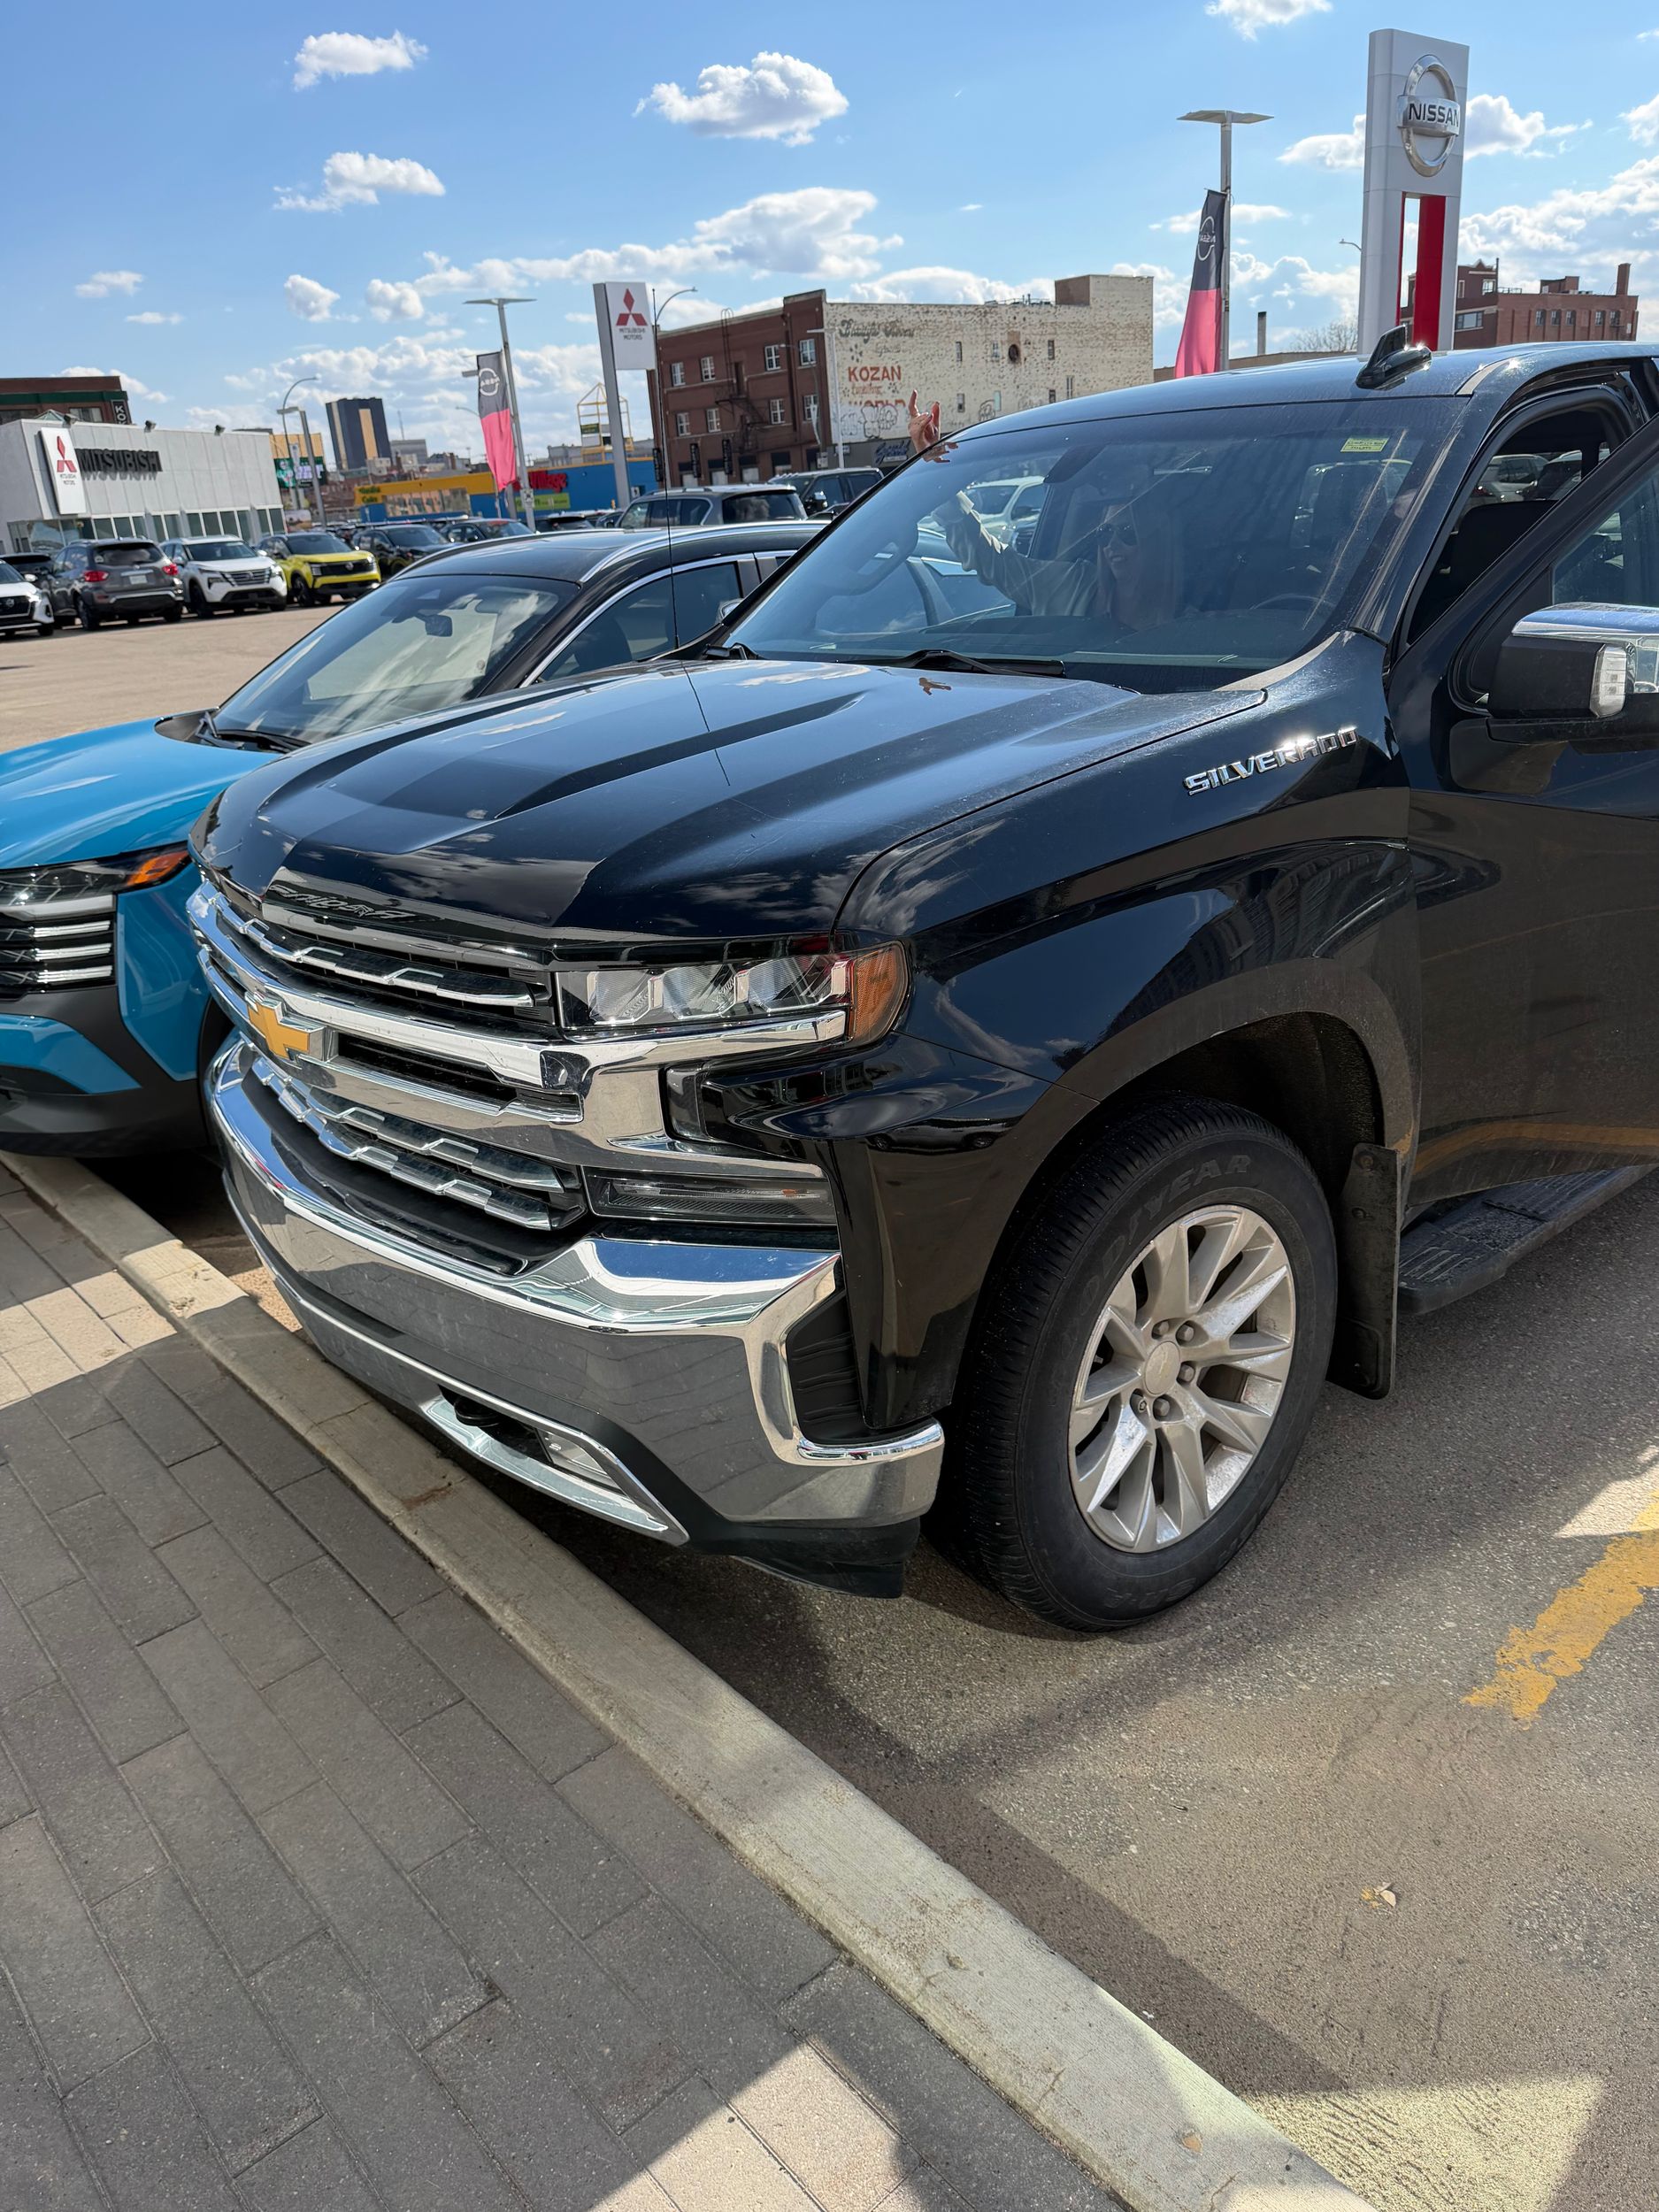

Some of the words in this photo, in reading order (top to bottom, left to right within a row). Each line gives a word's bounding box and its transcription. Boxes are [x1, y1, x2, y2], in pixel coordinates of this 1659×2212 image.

[1409, 103, 1459, 127] NISSAN
[848, 365, 902, 383] KOZAN
[74, 448, 163, 472] MITSUBISHI
[1183, 727, 1358, 795] SILVERADO
